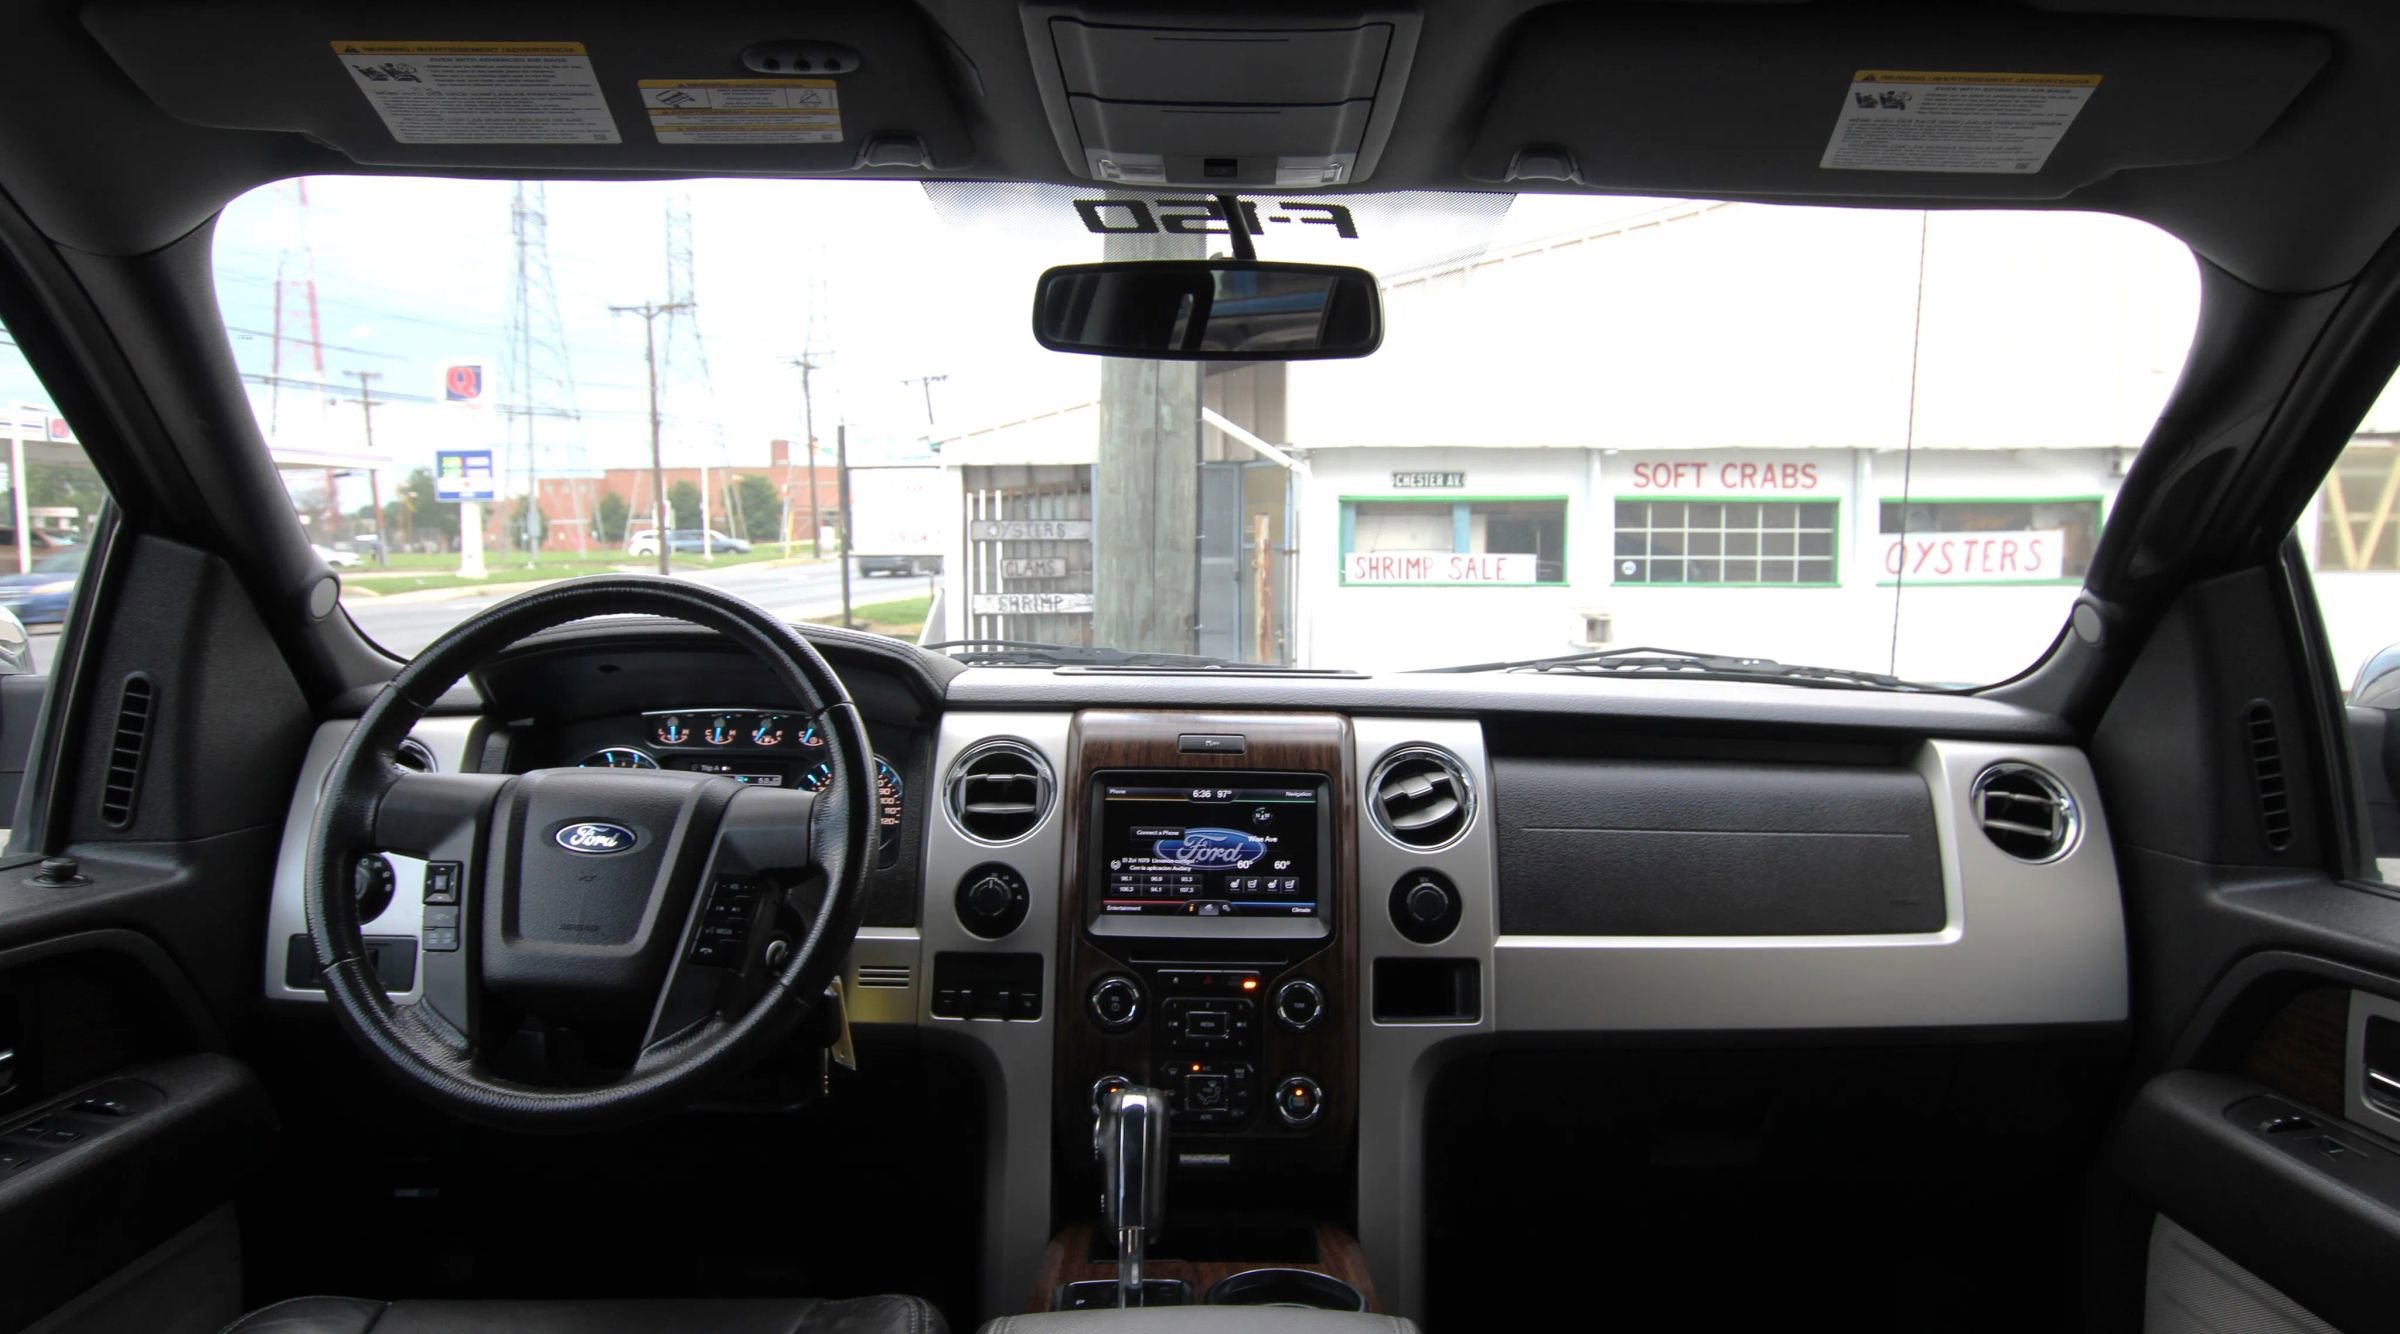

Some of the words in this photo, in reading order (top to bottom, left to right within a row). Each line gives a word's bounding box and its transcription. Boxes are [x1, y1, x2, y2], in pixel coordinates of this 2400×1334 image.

[1395, 473, 1443, 487] CHESTER
[1633, 462, 1708, 488] SOFT
[1720, 462, 1818, 489] CRABS
[986, 523, 1066, 537] OYSTERS
[1885, 539, 2042, 575] OYSTERS
[1005, 560, 1056, 577] CLAMS
[1355, 556, 1433, 580] SHRIMP
[1448, 556, 1507, 580] SALE
[998, 596, 1063, 611] SHRIMP
[1192, 790, 1212, 798] 6:36
[880, 817, 895, 825] 120
[570, 825, 620, 847] Ford
[1176, 834, 1242, 863] Ford
